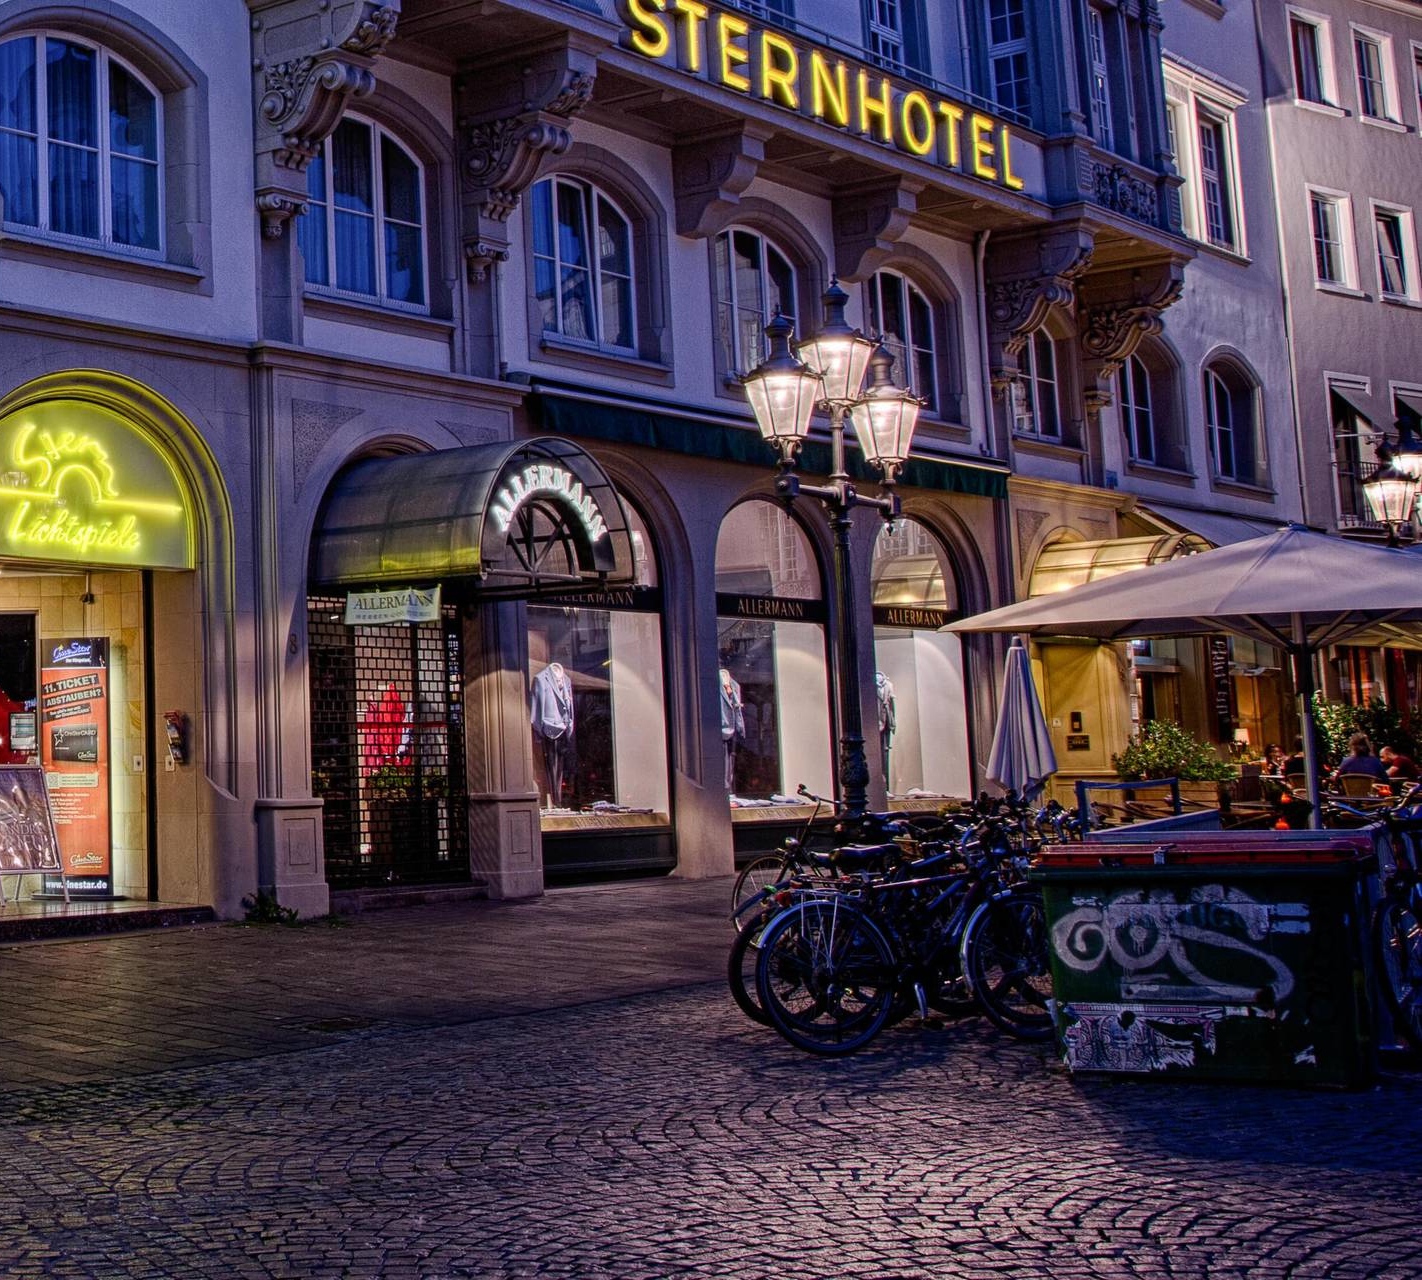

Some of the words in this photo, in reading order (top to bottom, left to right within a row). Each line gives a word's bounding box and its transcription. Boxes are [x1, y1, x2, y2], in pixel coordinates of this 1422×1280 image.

[628, 0, 1025, 191] STERNHOTEL
[492, 464, 608, 542] ALLERMANN
[9, 501, 141, 553] Lichtspiele
[353, 592, 434, 610] ALLERMANN
[738, 598, 804, 617] ALLERMANN
[887, 608, 944, 625] ALLERMANN
[56, 674, 97, 690] TICKET
[46, 687, 102, 707] ABSTAUBEN?
[45, 880, 108, 889] www.inestar.de
